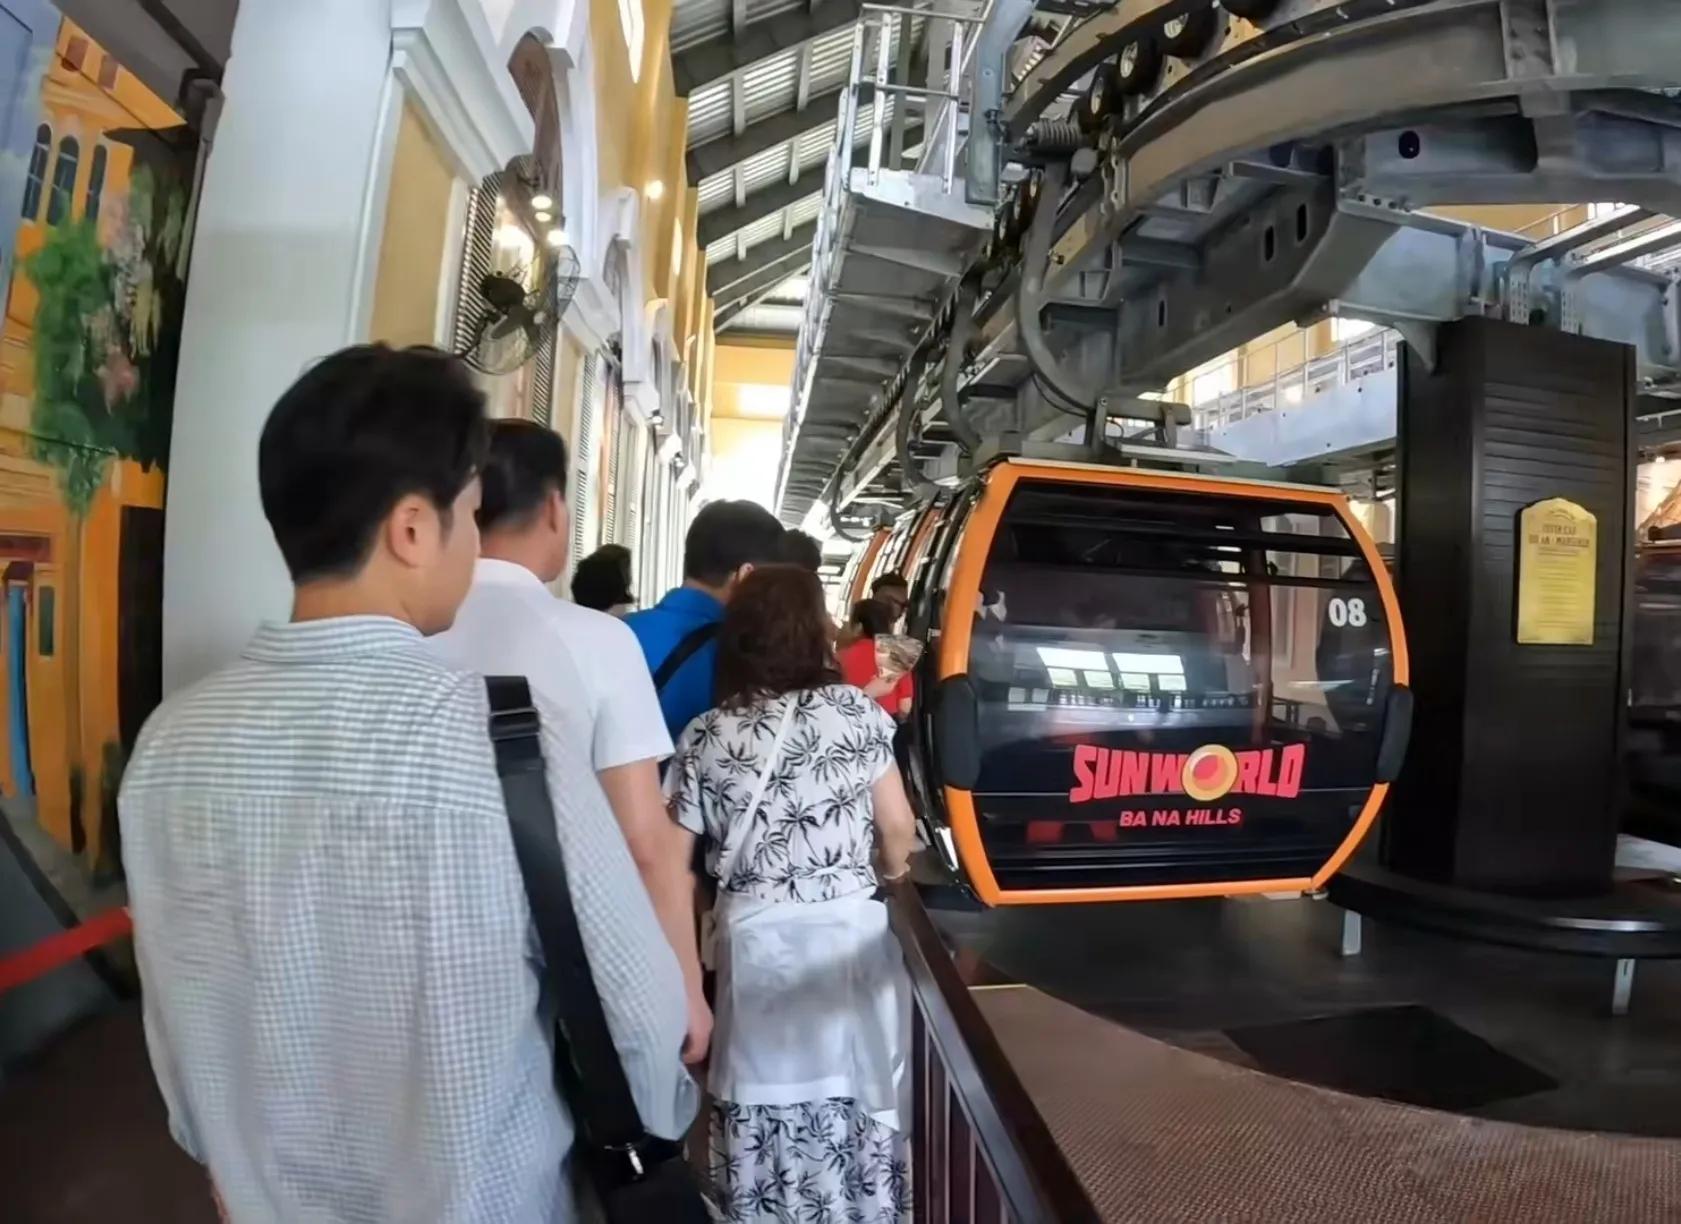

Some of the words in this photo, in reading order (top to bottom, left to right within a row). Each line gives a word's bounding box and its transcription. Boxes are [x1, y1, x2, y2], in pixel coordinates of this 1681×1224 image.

[1328, 597, 1367, 628] 08
[1119, 811, 1147, 827] BA
[1151, 810, 1181, 826] NA
[1185, 808, 1242, 826] HILLS
